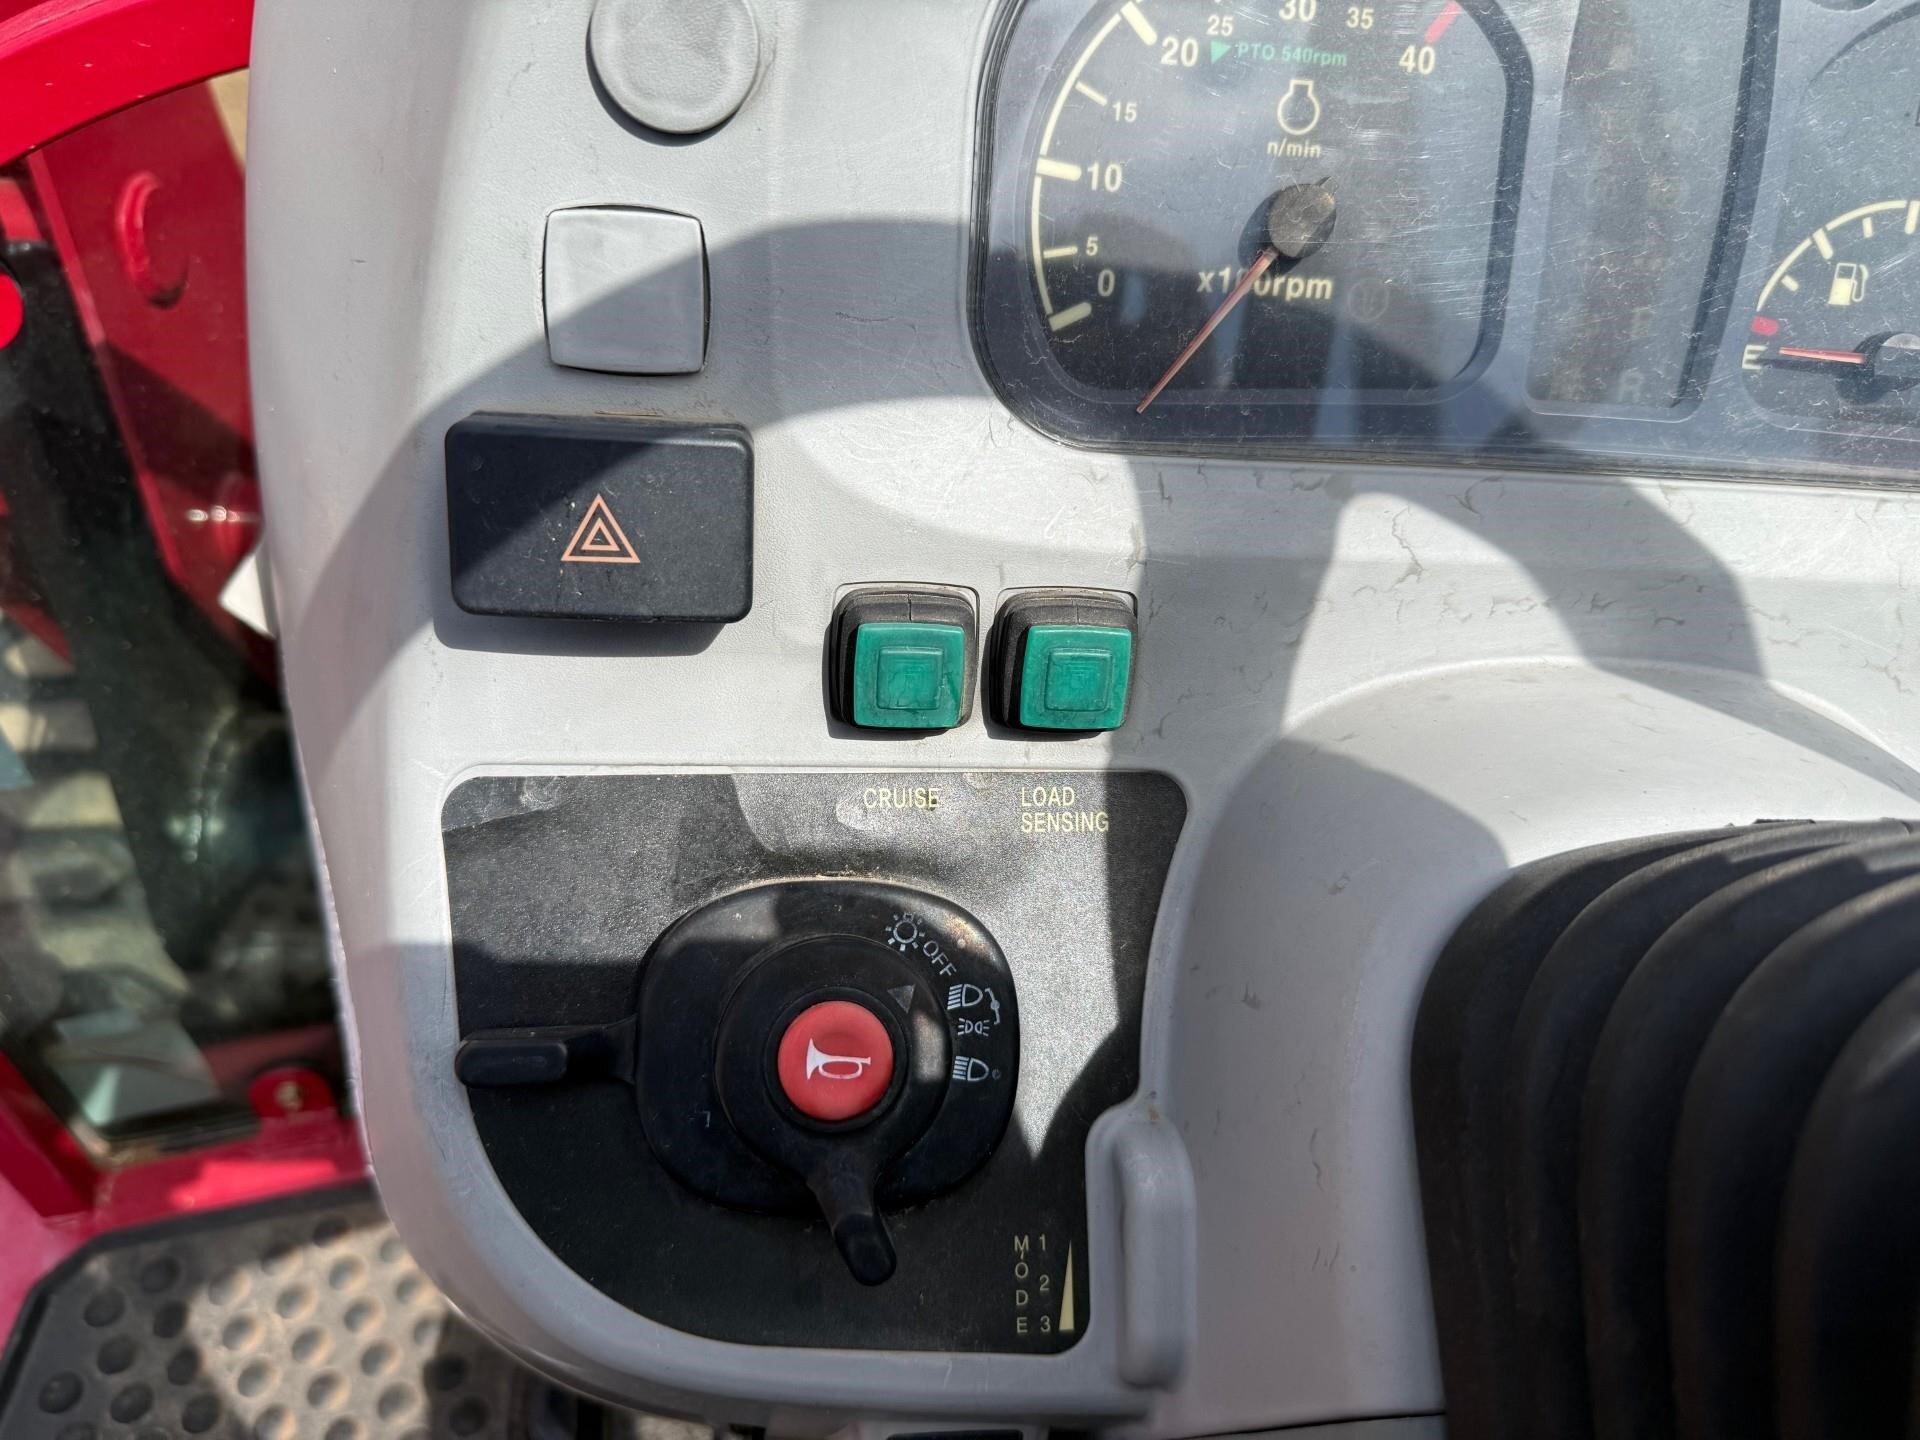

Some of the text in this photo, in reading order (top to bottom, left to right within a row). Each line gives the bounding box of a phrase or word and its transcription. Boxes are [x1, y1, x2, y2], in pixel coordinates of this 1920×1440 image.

[1279, 0, 1316, 21] 30
[1346, 7, 1374, 29] 35
[1207, 14, 1234, 36] 25
[1160, 36, 1199, 67] 20
[1237, 41, 1348, 67] PTO 540rpm
[1398, 44, 1436, 75] 40
[1112, 101, 1138, 123] 15
[1266, 137, 1322, 158] n/min
[1087, 162, 1123, 192] 10
[1085, 235, 1099, 256] 5
[1097, 268, 1116, 297] 0
[1742, 344, 1768, 370] E
[863, 787, 940, 809] CRUISE
[1020, 786, 1076, 808] LOAD
[1020, 811, 1110, 834] SENSING
[922, 939, 958, 977] OFF
[1039, 1233, 1047, 1251] 1
[1039, 1274, 1050, 1291] 2
[1040, 1314, 1051, 1333] 3
